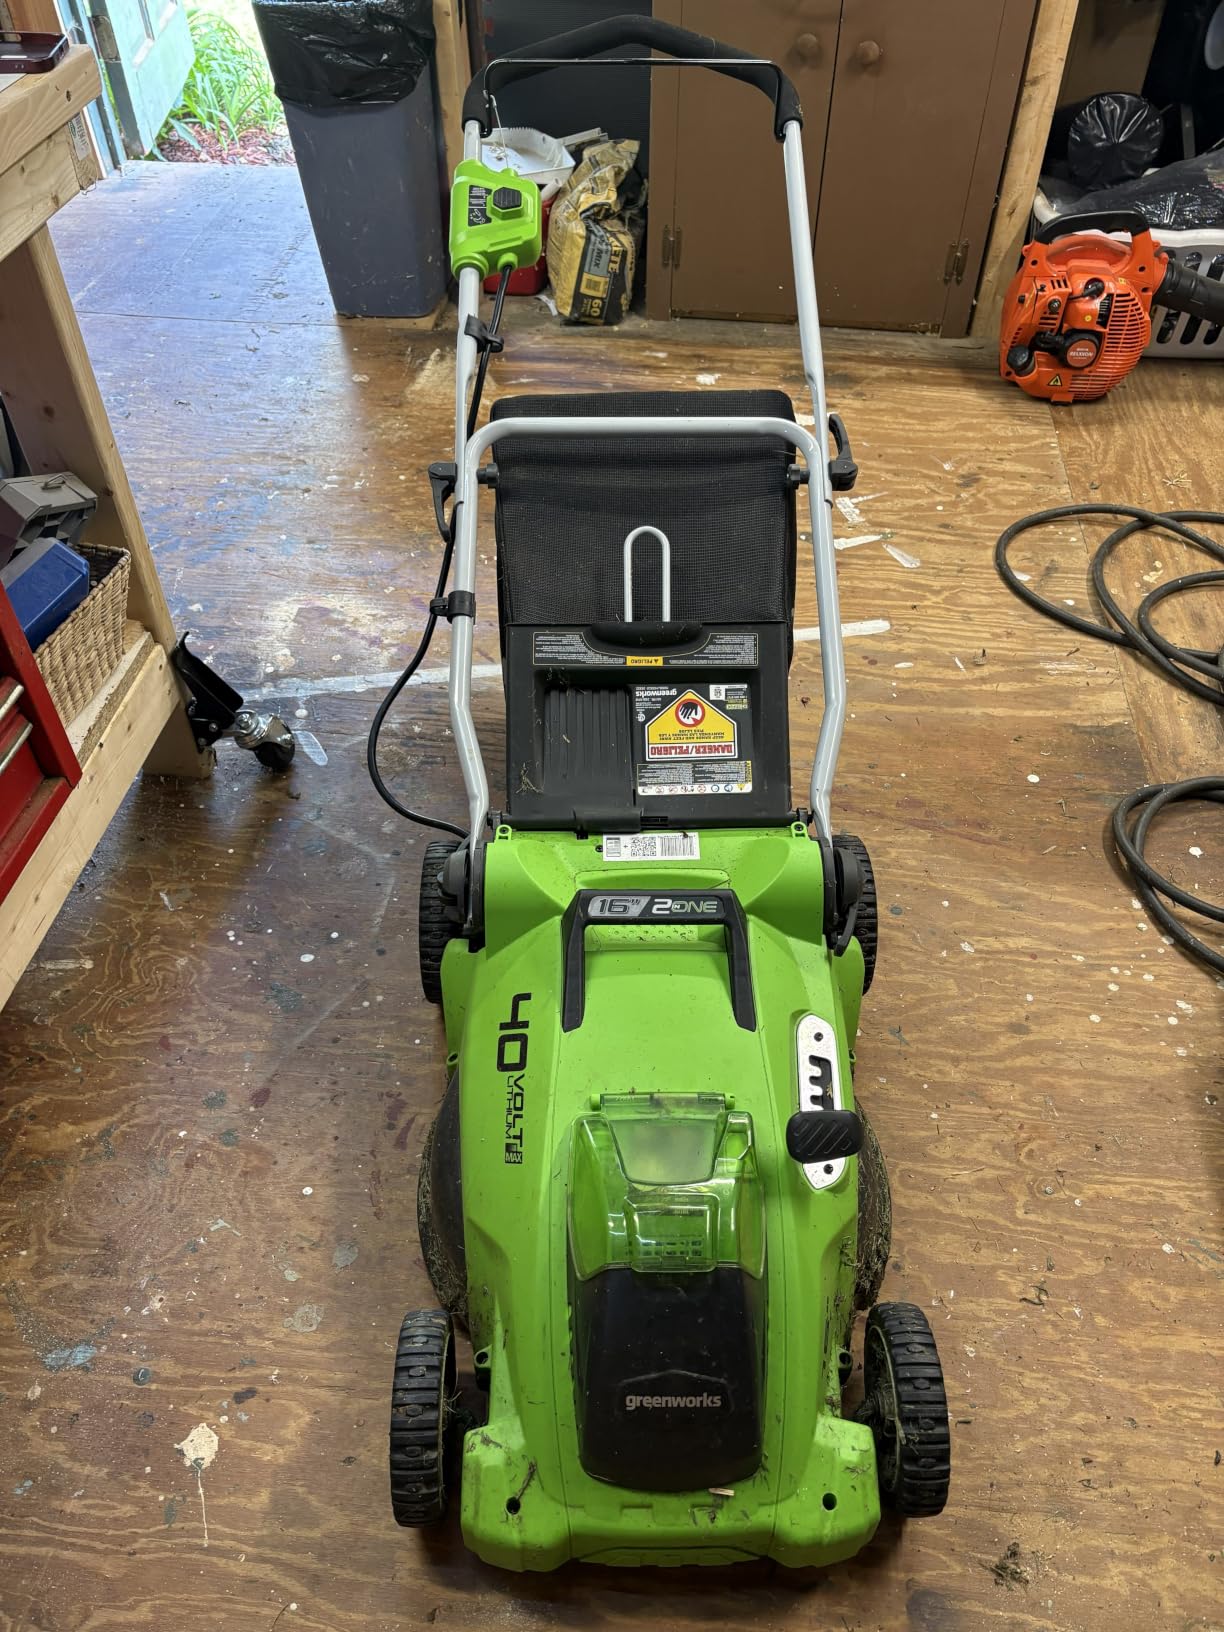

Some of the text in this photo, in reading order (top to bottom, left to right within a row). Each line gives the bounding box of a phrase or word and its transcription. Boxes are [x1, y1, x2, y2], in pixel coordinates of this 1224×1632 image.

[590, 299, 602, 317] 60
[635, 688, 677, 698] greenworks
[497, 992, 532, 1148] 40 VOLT
[505, 1075, 514, 1140] LITHIUM
[505, 1152, 522, 1164] MAX
[625, 1391, 722, 1411] greenworks
